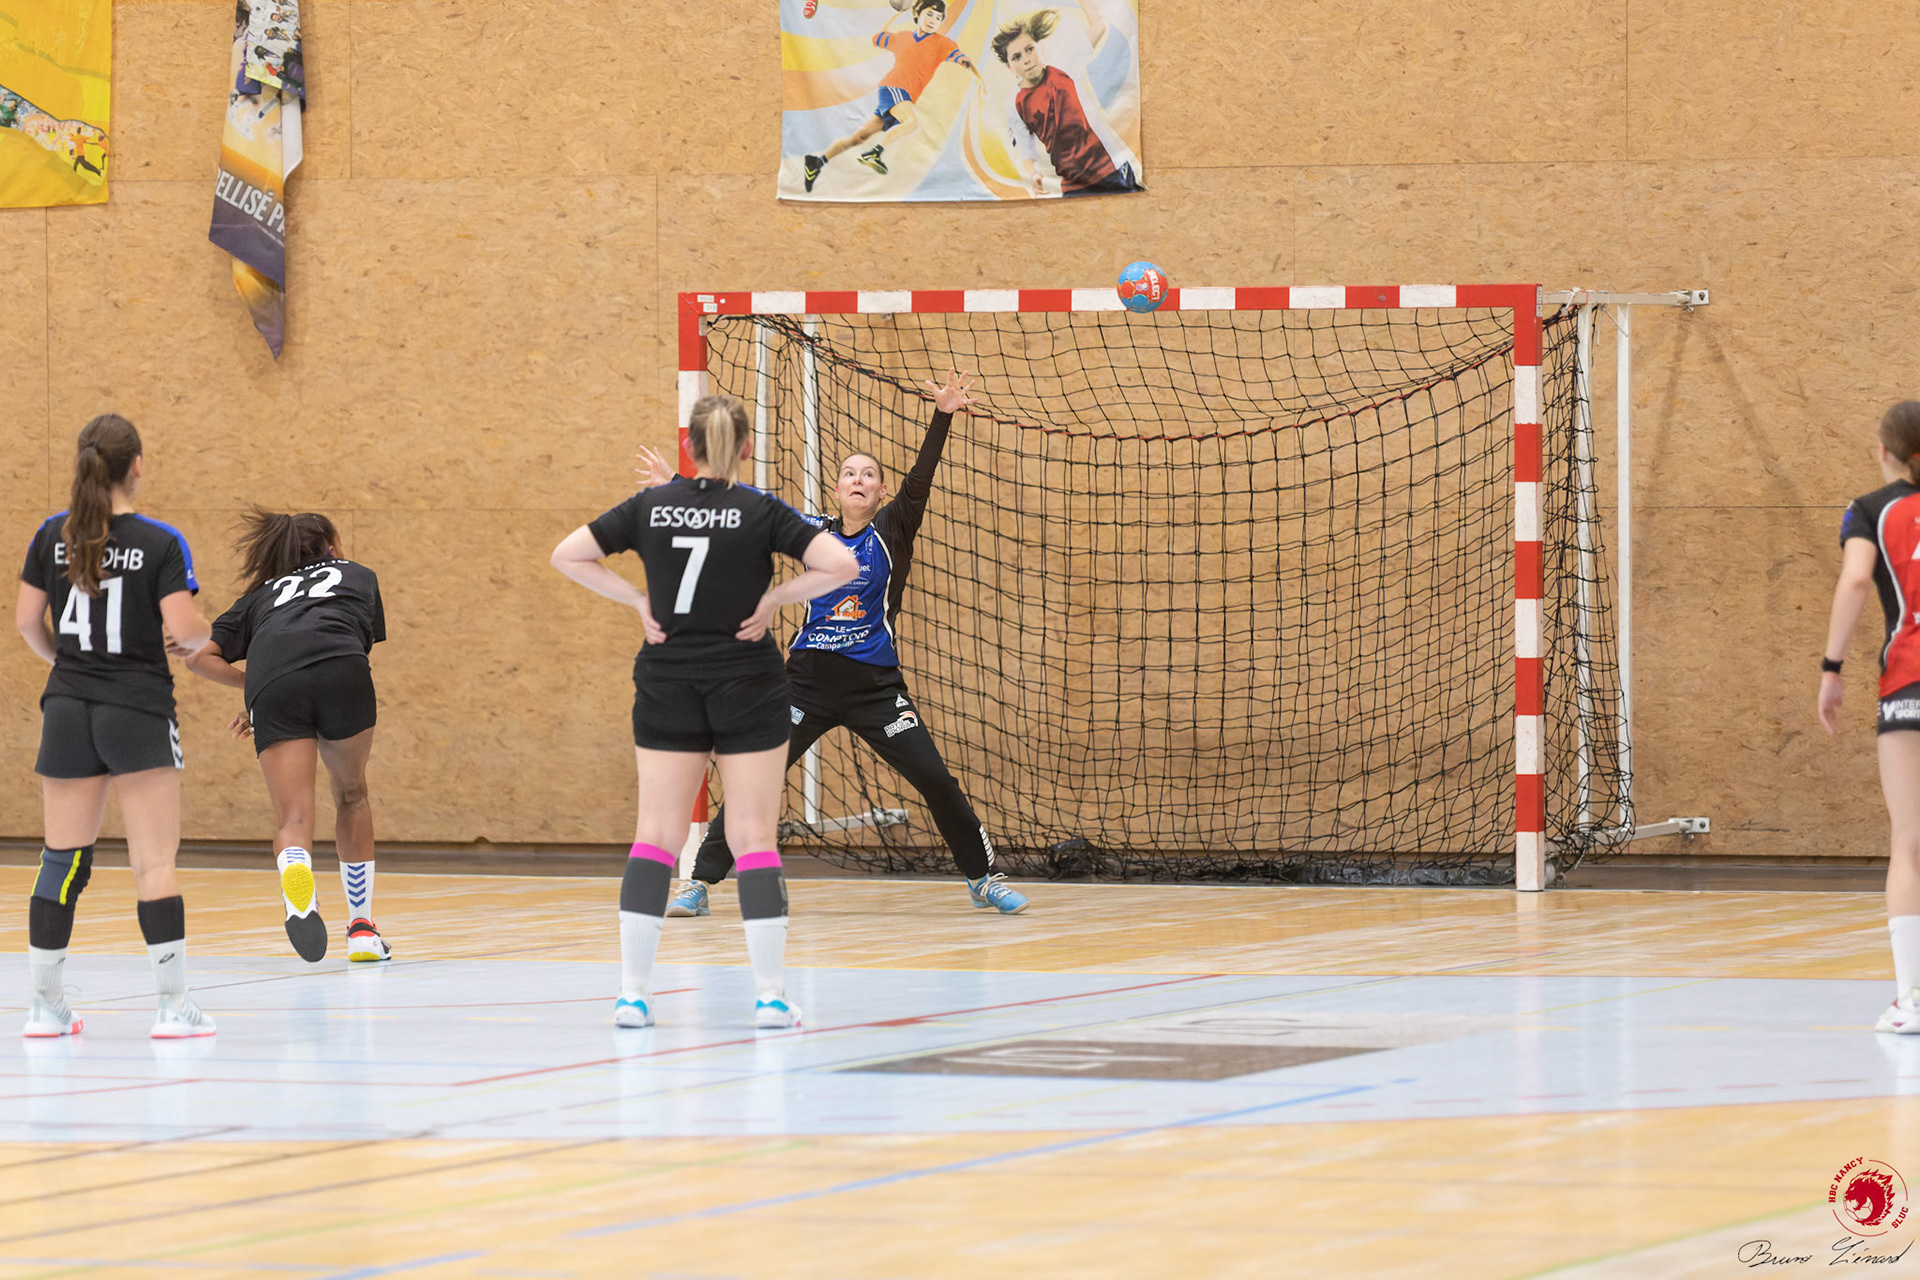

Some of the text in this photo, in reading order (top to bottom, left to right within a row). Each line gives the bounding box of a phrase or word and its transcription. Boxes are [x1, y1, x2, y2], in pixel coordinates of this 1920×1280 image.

[214, 166, 275, 222] ELLISÉ
[272, 566, 343, 608] 22
[671, 536, 710, 614] 7
[59, 576, 124, 655] 41
[835, 626, 846, 634] LE
